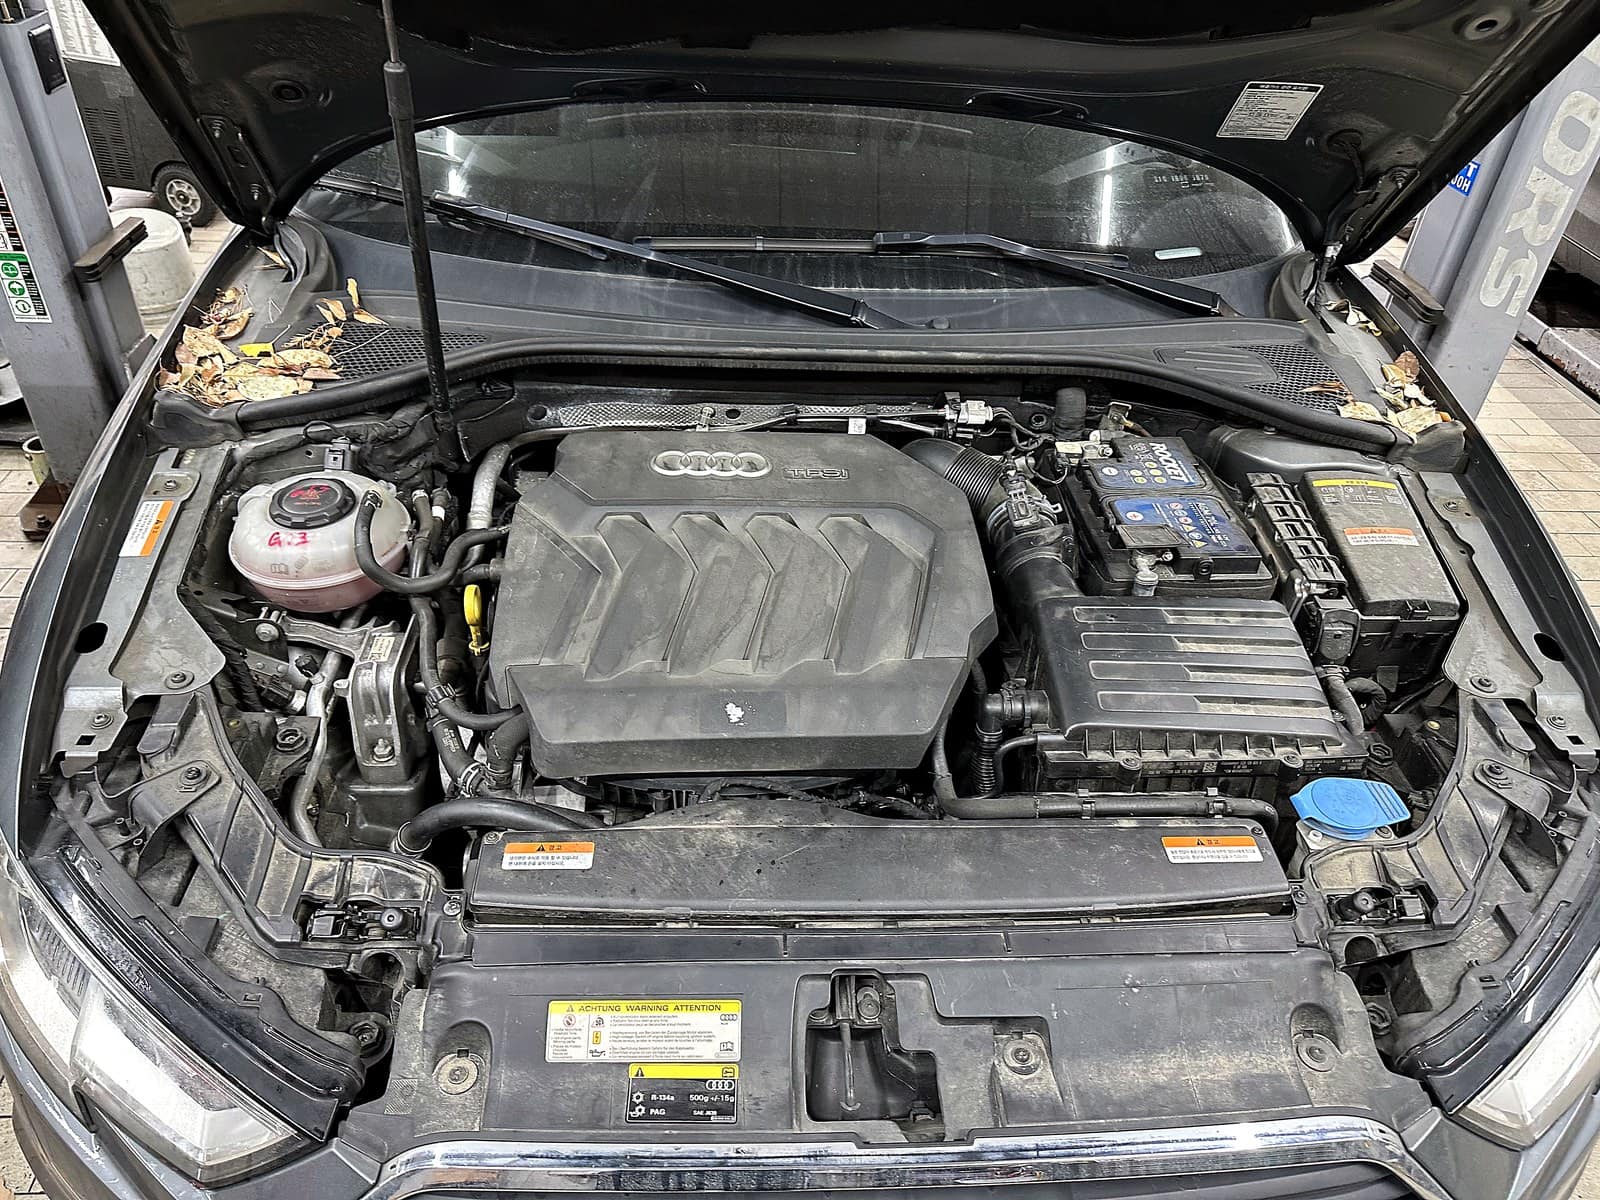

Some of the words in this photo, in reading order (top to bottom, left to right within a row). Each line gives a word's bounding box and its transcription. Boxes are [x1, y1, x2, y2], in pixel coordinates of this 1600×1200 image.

[1479, 44, 1600, 318] ORS
[1149, 442, 1187, 481] ROCKET
[785, 467, 850, 480] TFSI
[578, 1004, 621, 1012] ACHTUNG
[626, 1004, 669, 1012] WARNING
[689, 1094, 709, 1103] 500g
